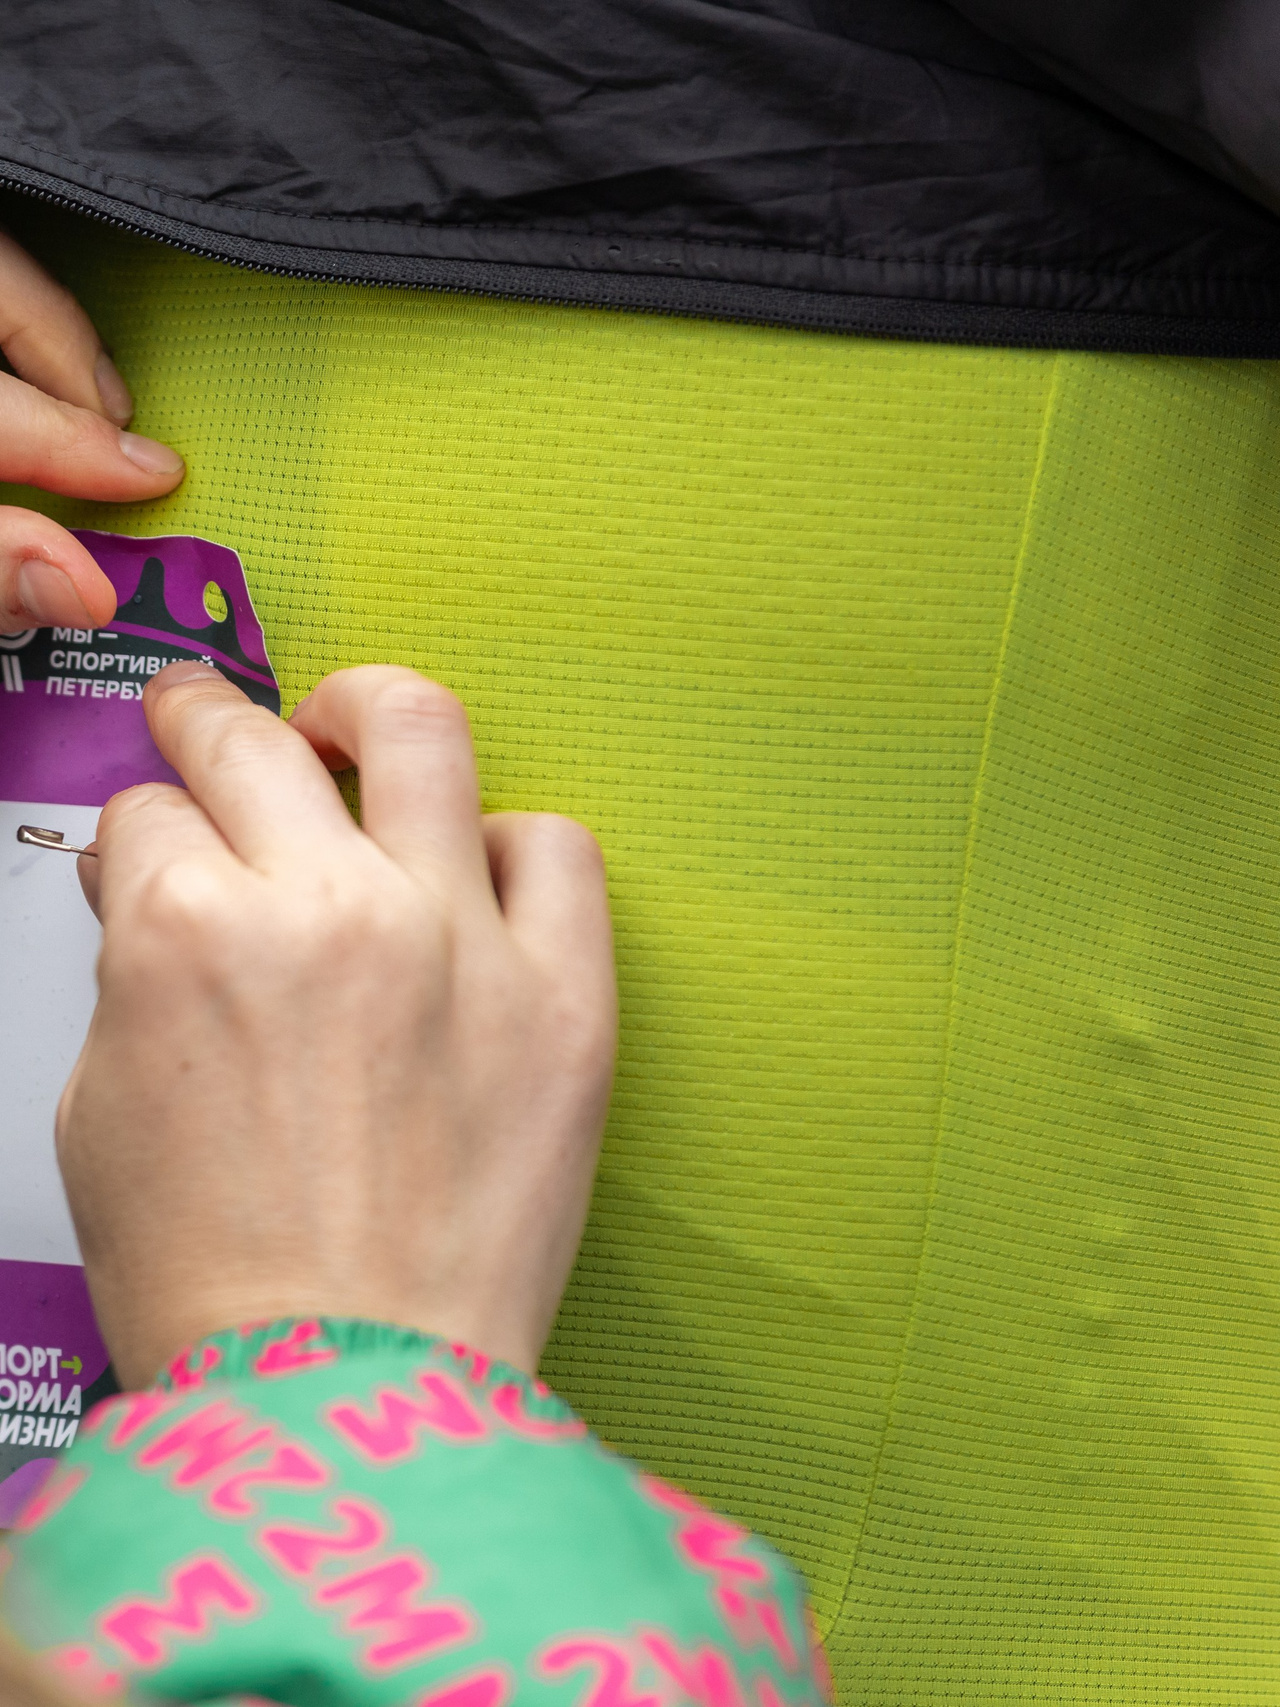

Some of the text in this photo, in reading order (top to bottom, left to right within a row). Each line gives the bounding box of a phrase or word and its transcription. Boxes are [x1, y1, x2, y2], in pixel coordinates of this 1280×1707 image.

[52, 627, 93, 644] МЫ
[49, 650, 215, 675] СПОРТИВ
[45, 676, 144, 700] ПЕТЕРБУ
